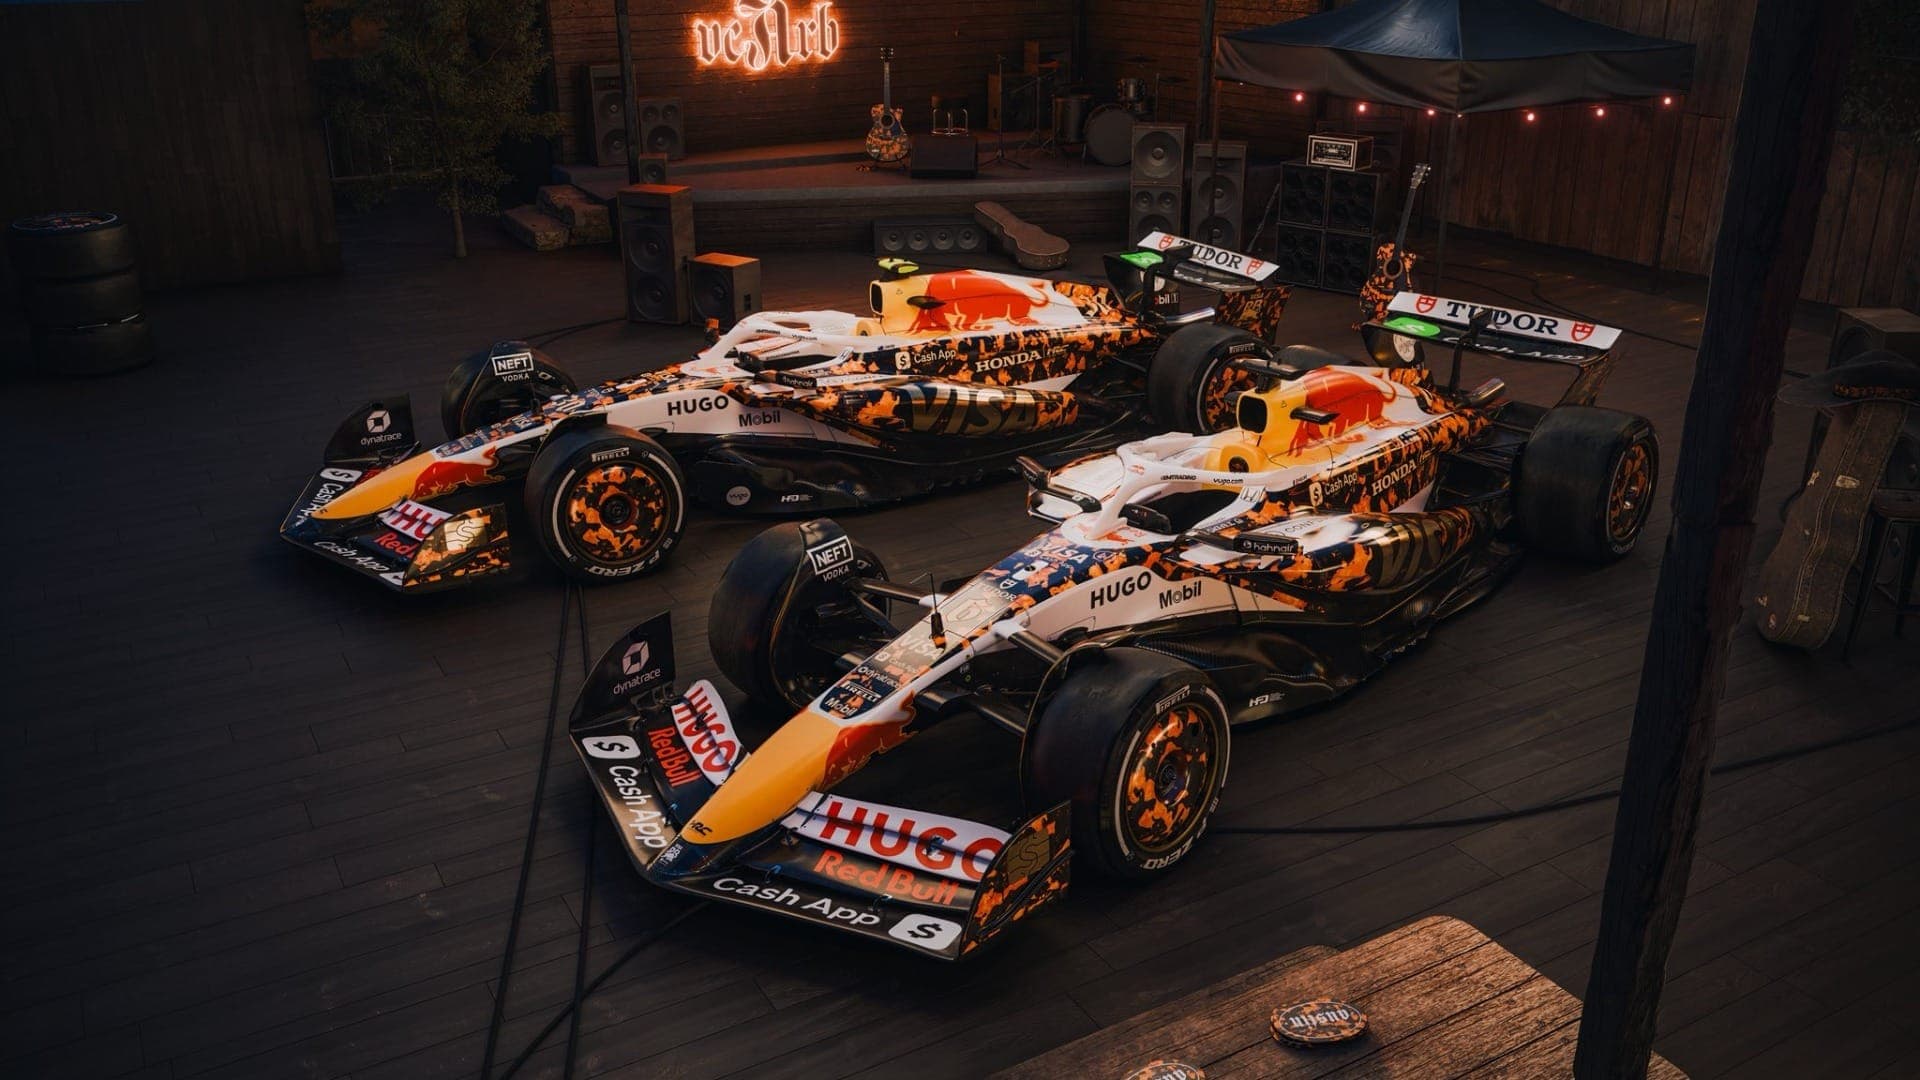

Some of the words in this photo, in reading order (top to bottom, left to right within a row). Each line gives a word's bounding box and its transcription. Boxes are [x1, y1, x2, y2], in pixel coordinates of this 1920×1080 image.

[497, 356, 528, 372] NEFT
[913, 350, 938, 364] Cash
[938, 347, 957, 361] App
[975, 350, 1042, 373] HONDA
[502, 372, 530, 382] VODKA
[668, 395, 729, 416] HUGO
[739, 410, 781, 427] Mobil
[907, 382, 1037, 436] VISA
[360, 431, 402, 446] dynatrace
[592, 447, 630, 463] PIRELLI
[1324, 475, 1344, 496] Cash
[1342, 470, 1359, 486] App
[1371, 458, 1417, 497] HONDA
[392, 503, 444, 540] HU
[314, 541, 357, 560] Cash
[351, 556, 390, 572] App
[374, 531, 416, 560] Red
[815, 543, 848, 567] NEFT
[1253, 542, 1294, 553] hahnair
[587, 564, 645, 577] ZERO
[822, 565, 850, 582] VODKA
[1090, 571, 1151, 609] HUGO
[1159, 580, 1201, 609] Mobil
[613, 667, 662, 695] dynatrace
[840, 680, 883, 702] PIRELLI
[824, 697, 859, 716] Mobil
[1155, 684, 1191, 716] PIRELLI
[674, 686, 737, 773] HUGO
[609, 765, 653, 806] Cash
[629, 808, 668, 850] App
[1142, 836, 1194, 870] ZERO
[712, 876, 800, 907] Cash
[801, 896, 881, 928] App
